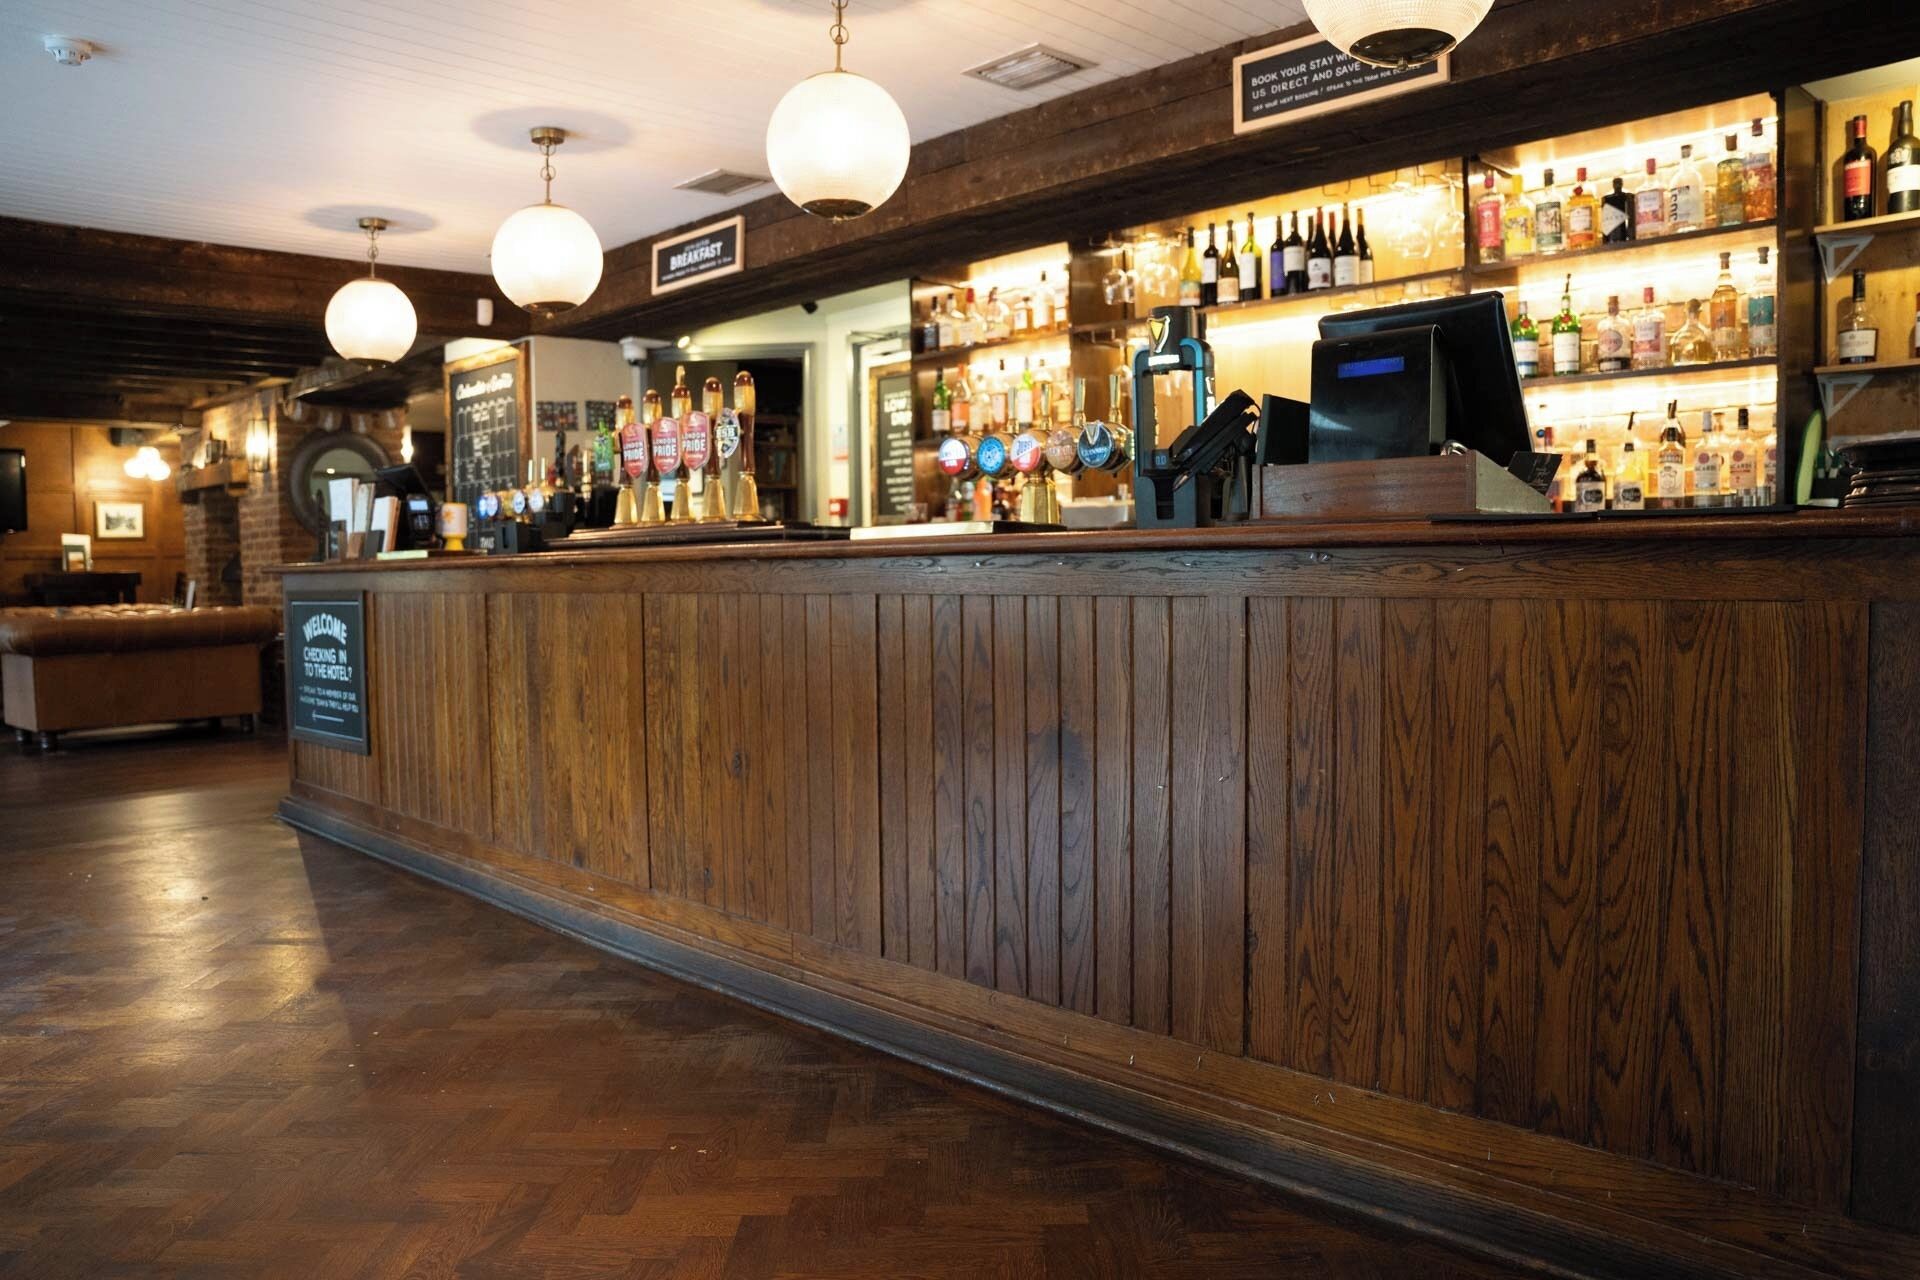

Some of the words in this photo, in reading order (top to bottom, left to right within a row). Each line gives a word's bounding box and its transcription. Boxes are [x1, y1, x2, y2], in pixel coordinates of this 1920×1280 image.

[1251, 72, 1279, 87] BOOK
[1280, 63, 1307, 78] YOUR
[1309, 55, 1334, 70] STAY
[1251, 88, 1266, 100] US
[1271, 76, 1309, 94] DIRECT
[1312, 69, 1333, 83] AND
[1335, 61, 1361, 77] SAVE
[670, 240, 723, 271] BREAKFAST
[653, 444, 677, 458] PRIDE
[682, 439, 706, 452] PRIDE
[302, 612, 347, 645] WELCOME
[303, 646, 336, 665] CHECKING
[338, 648, 347, 665] IN
[304, 662, 314, 677] TO
[314, 663, 327, 679] THE
